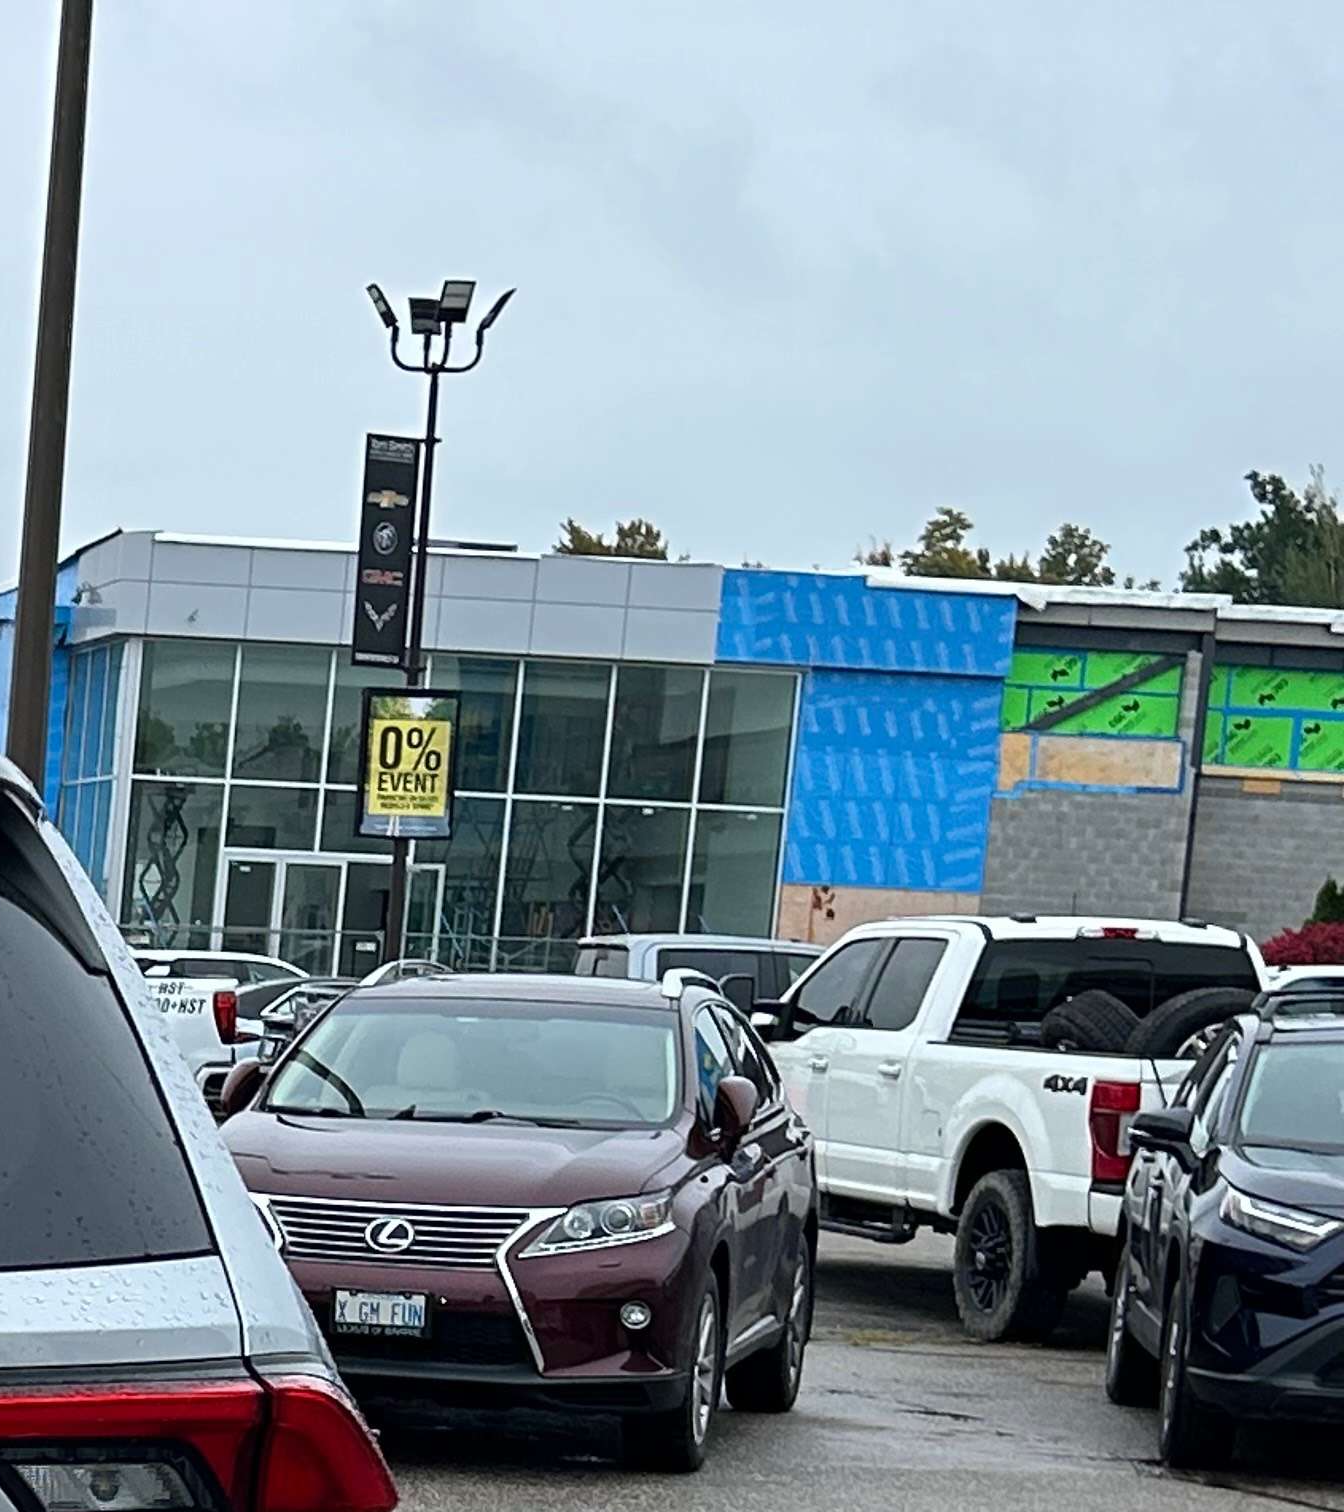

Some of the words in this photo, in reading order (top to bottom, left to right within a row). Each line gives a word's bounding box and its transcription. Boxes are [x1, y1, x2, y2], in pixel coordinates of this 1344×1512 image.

[379, 725, 441, 771] 0%
[377, 772, 440, 794] EVENT
[391, 1303, 423, 1326] FUN
